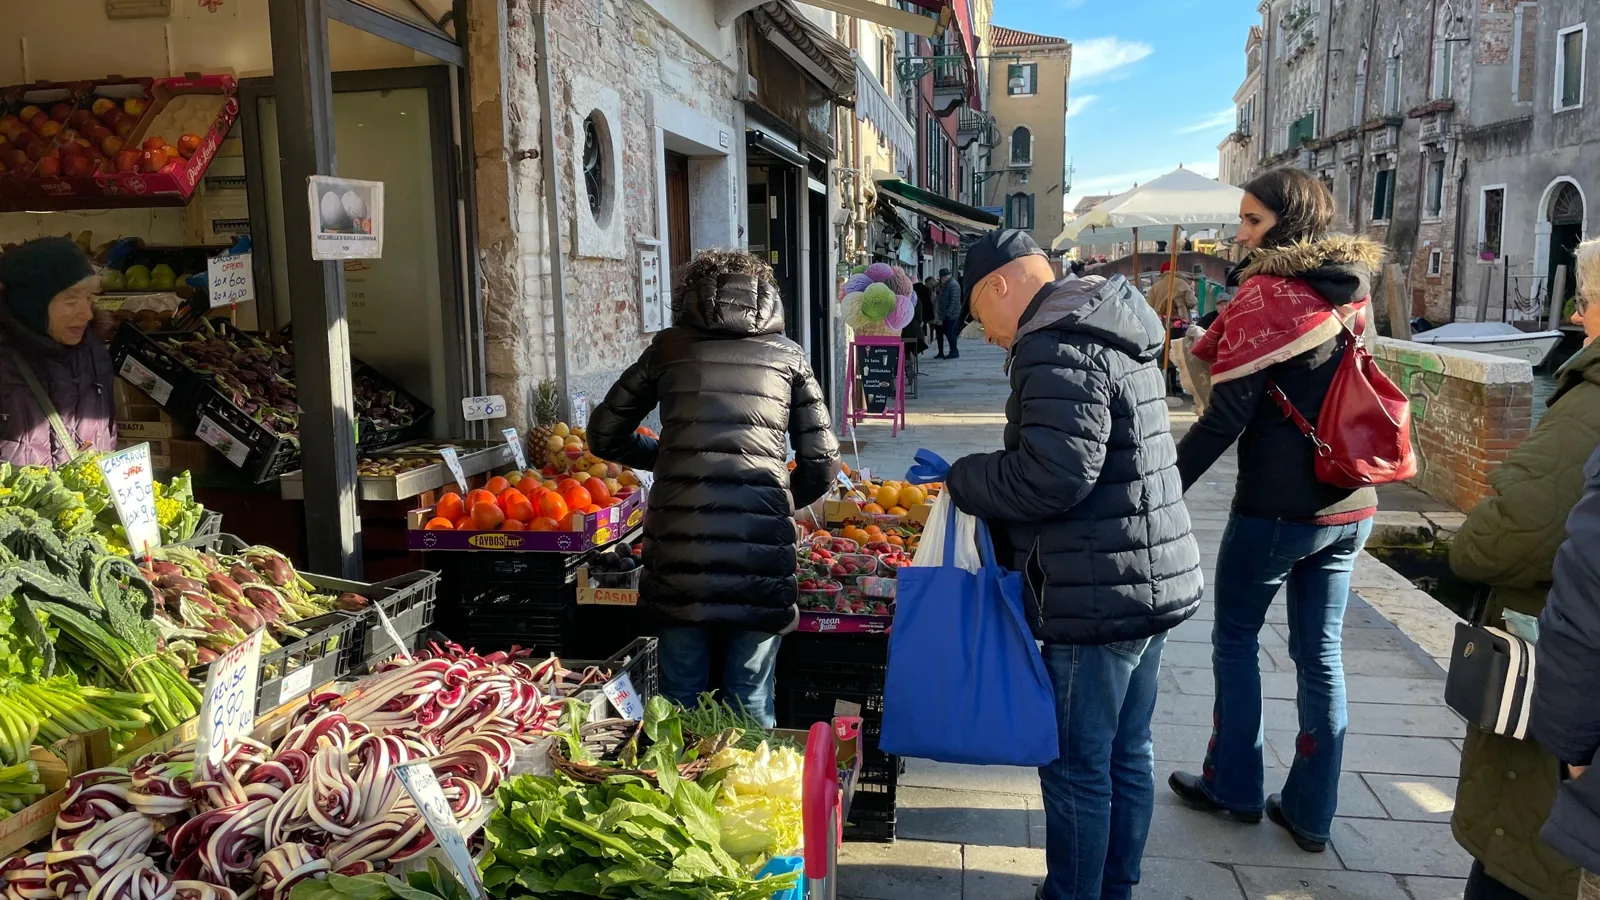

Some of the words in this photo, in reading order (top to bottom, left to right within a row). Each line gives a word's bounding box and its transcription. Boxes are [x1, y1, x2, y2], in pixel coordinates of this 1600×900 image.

[187, 157, 204, 186] Pink
[203, 136, 217, 164] Lady
[118, 488, 127, 505] 5
[475, 535, 504, 547] FAYBOS
[594, 589, 639, 604] CASAL
[217, 635, 256, 677] OFFERTA
